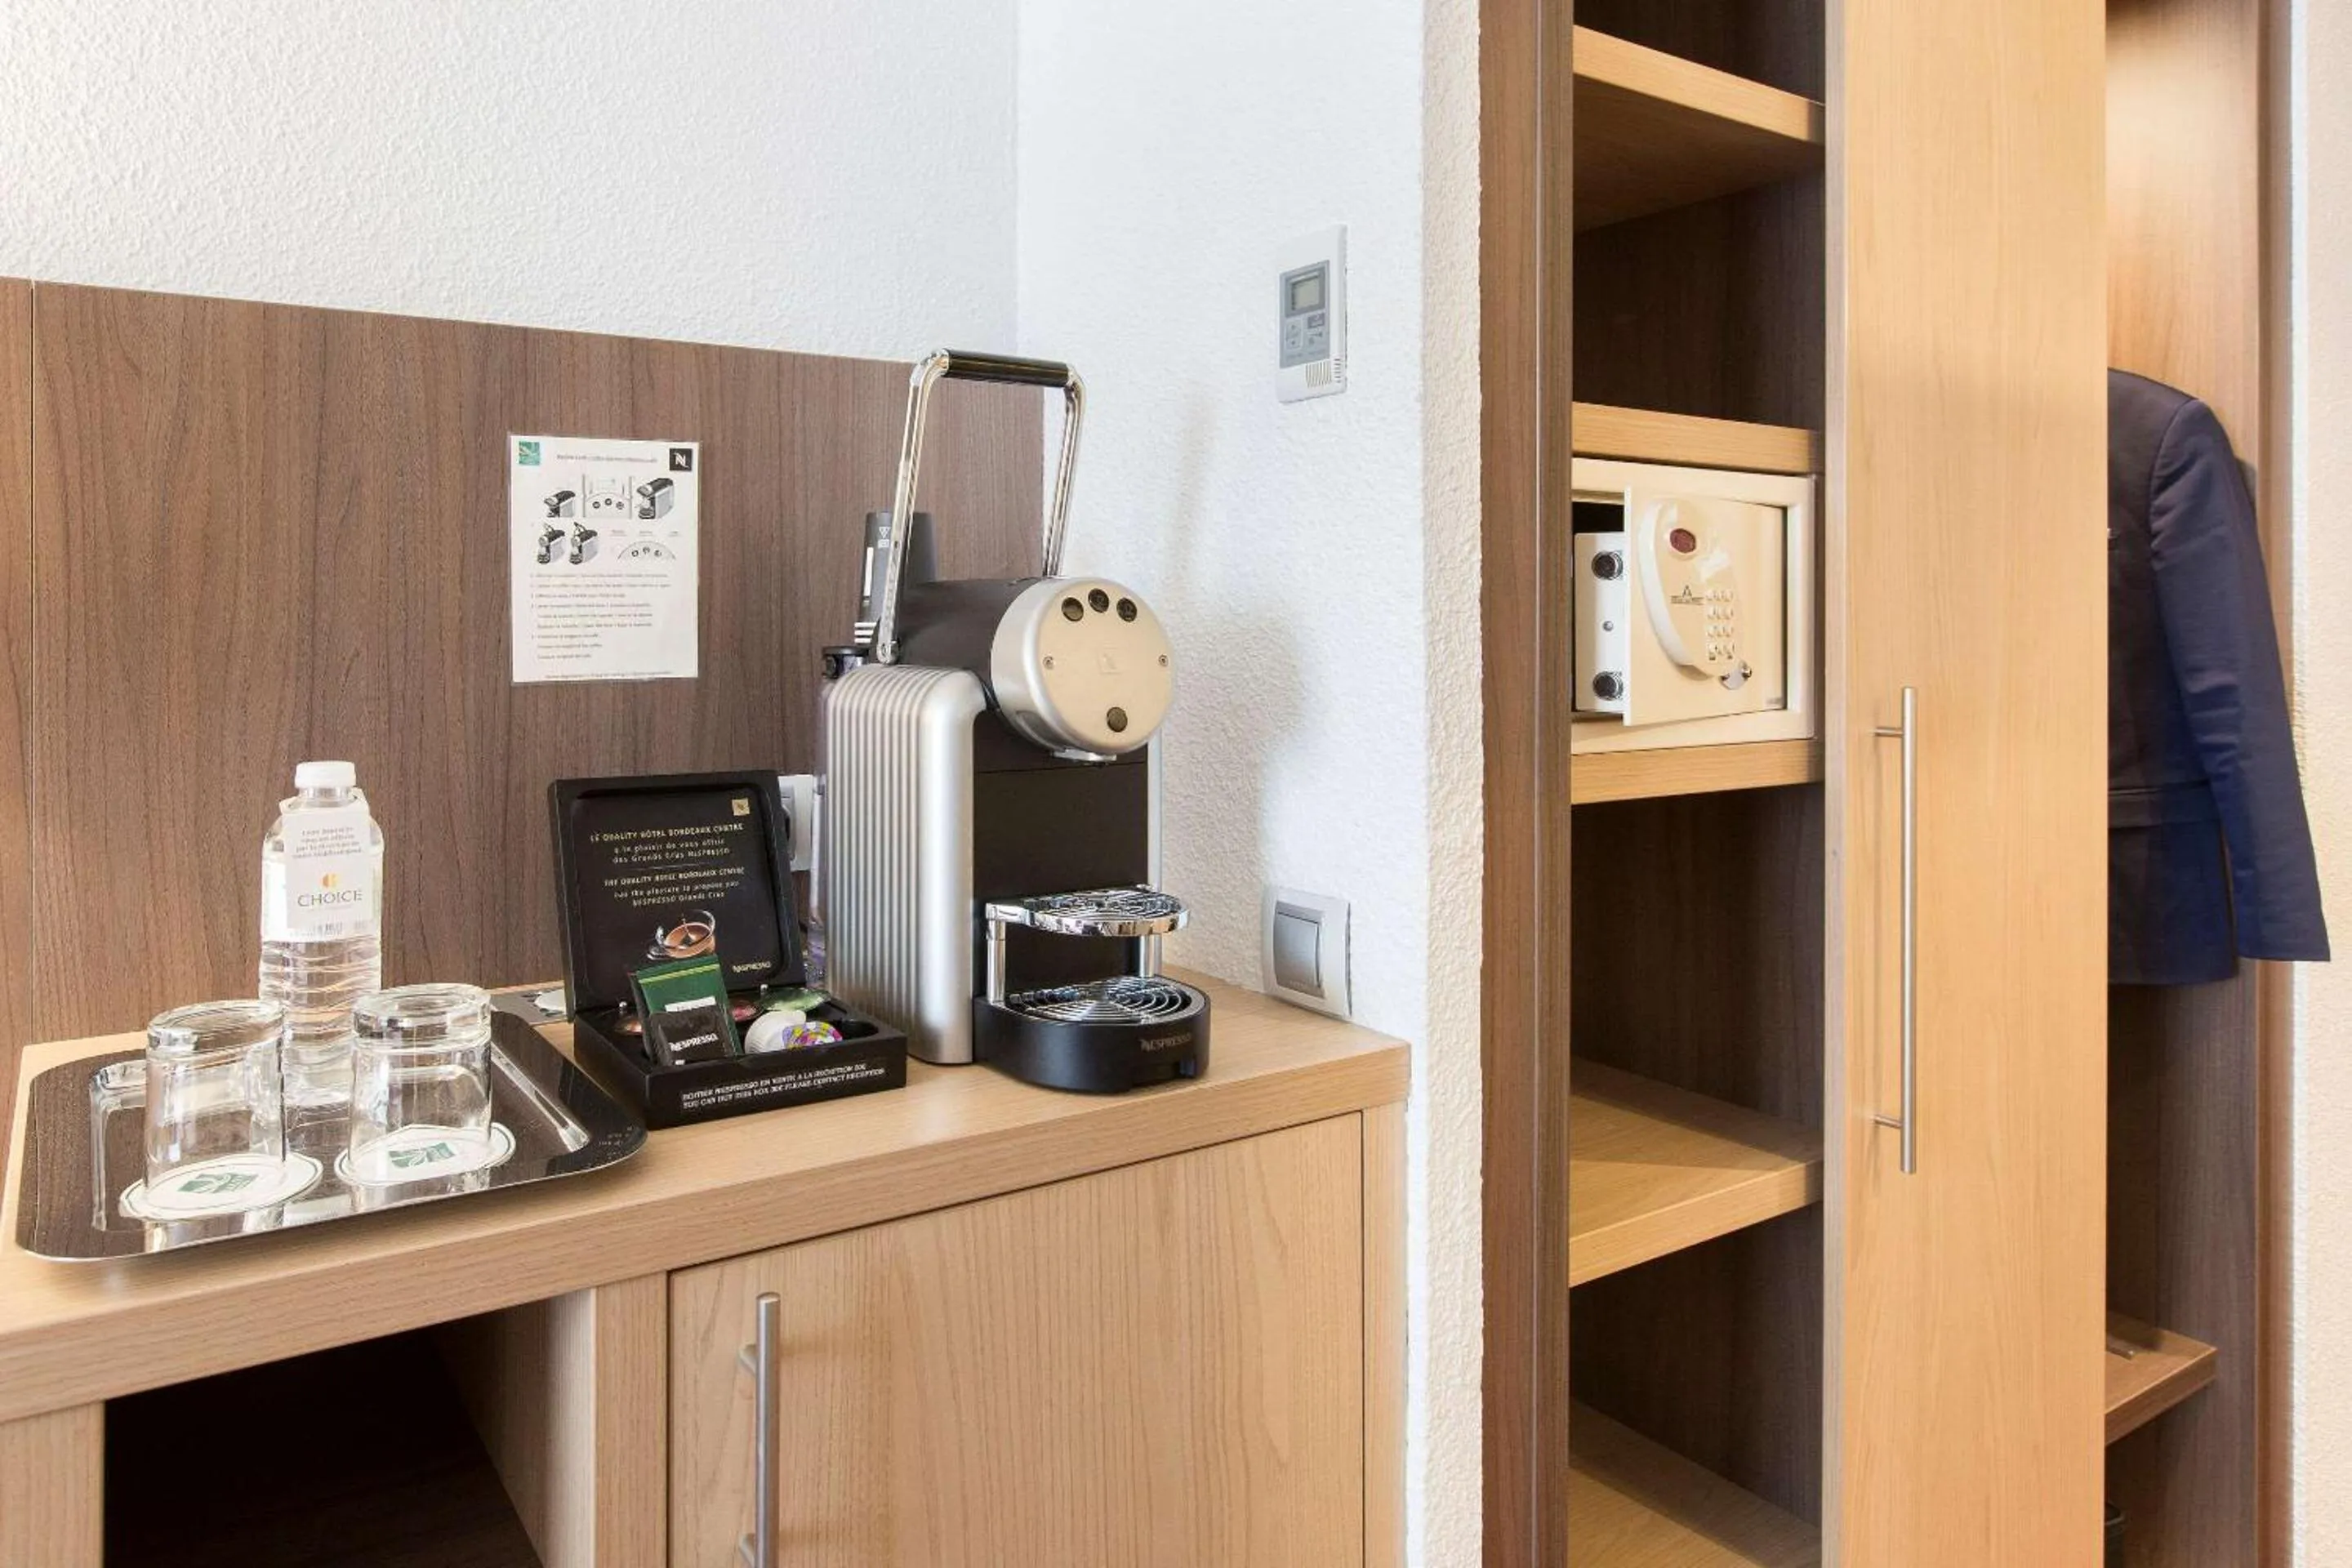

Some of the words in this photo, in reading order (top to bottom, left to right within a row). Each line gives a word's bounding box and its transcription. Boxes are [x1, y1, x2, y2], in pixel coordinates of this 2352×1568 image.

[603, 831, 638, 842] QUALITY
[668, 826, 711, 837] BORDEAUX
[713, 822, 745, 833] CENTRE
[620, 875, 653, 886] QUALITY
[296, 889, 363, 907] CHOICE
[667, 1032, 719, 1053] NESPRESSO
[1138, 1033, 1192, 1053] NESPRESSO
